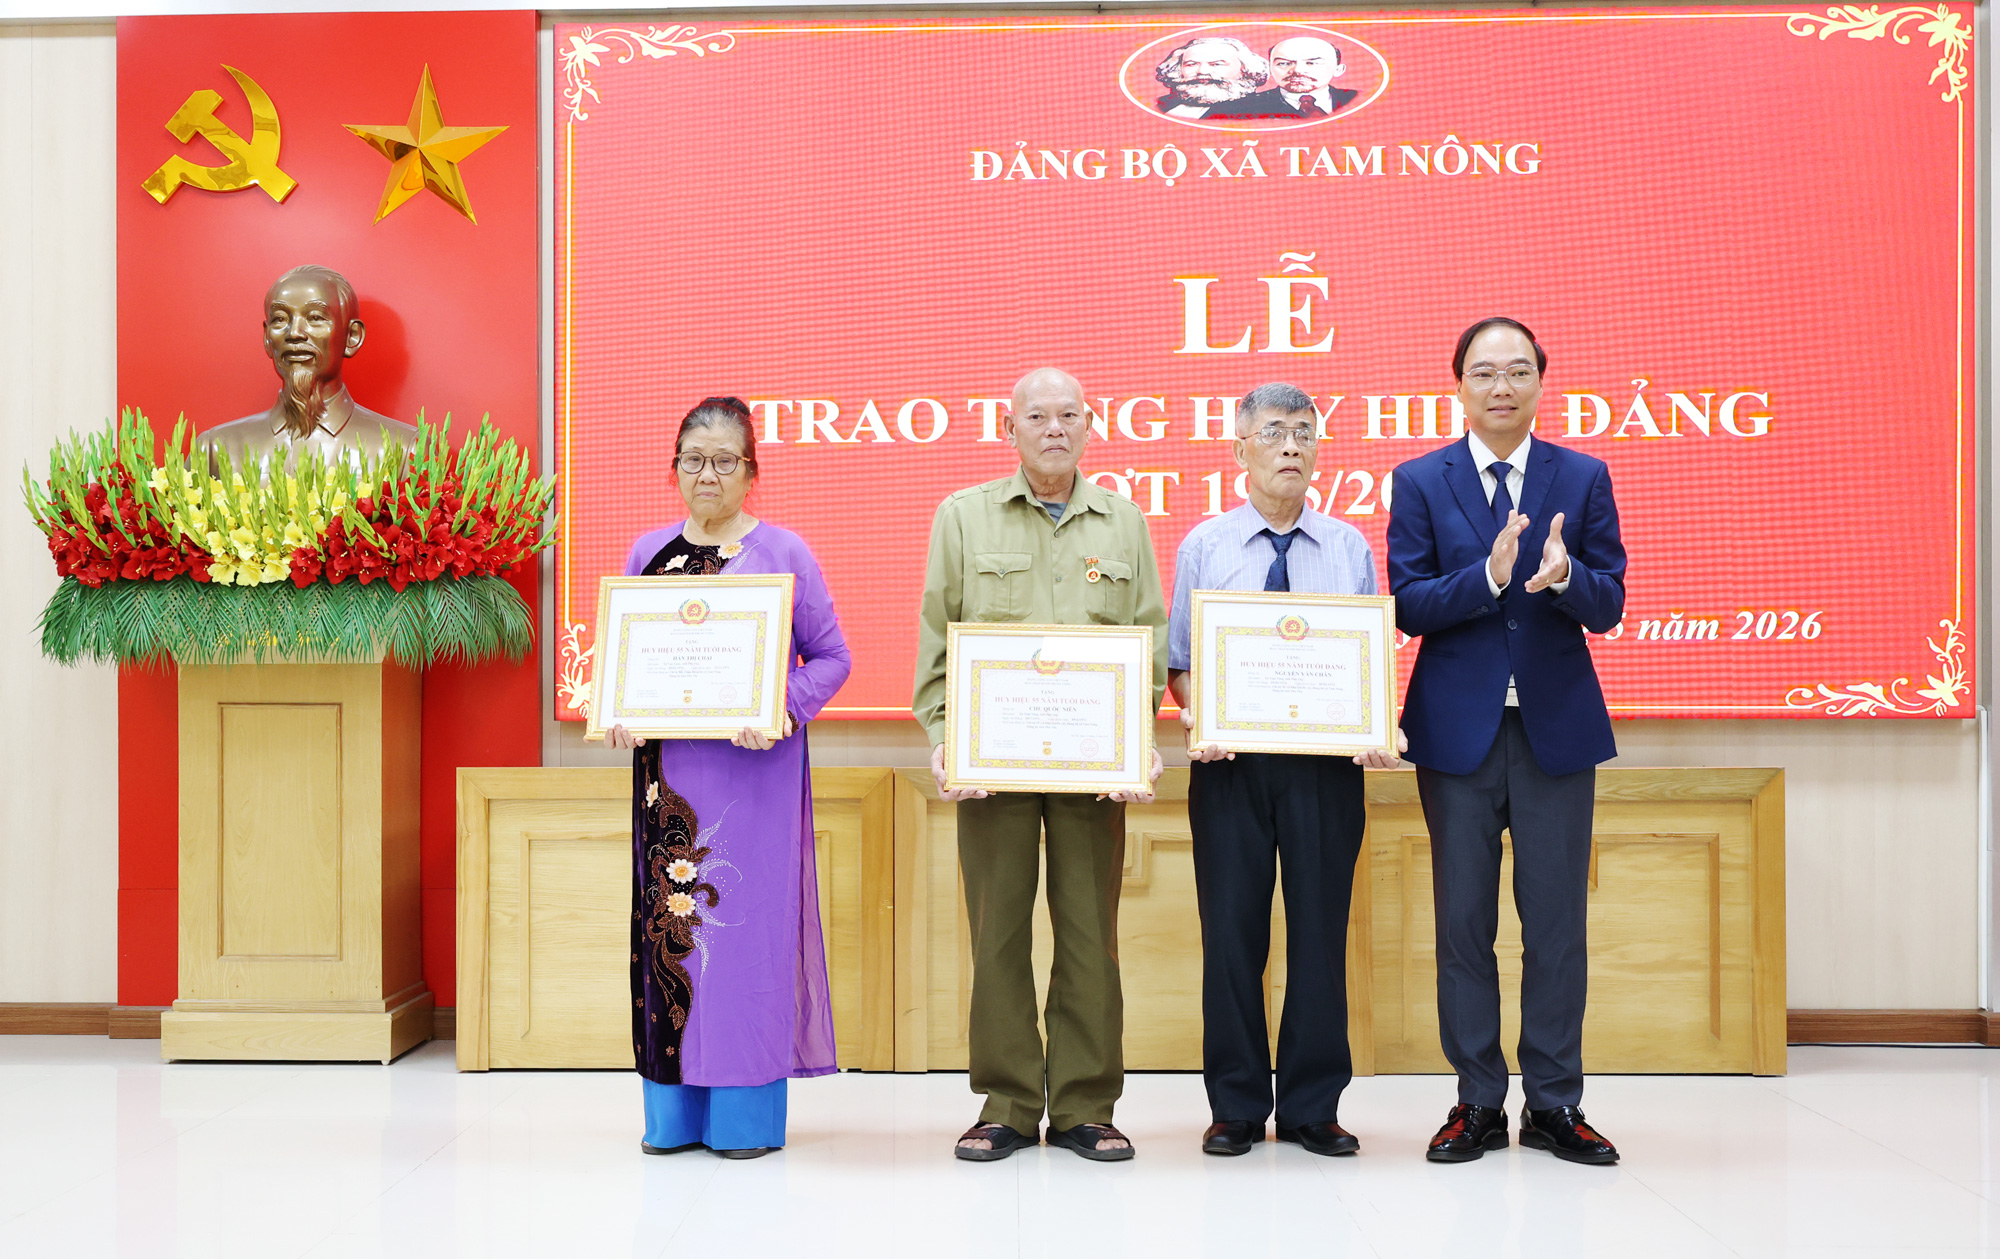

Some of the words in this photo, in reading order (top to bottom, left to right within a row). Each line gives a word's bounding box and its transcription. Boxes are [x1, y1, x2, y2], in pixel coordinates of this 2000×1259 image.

[970, 141, 1108, 181] ĐẢNG
[1120, 143, 1188, 187] BỘ
[1201, 139, 1268, 178] XÃ
[1280, 145, 1386, 177] TAM
[1398, 134, 1542, 175] NÔNG
[1173, 251, 1335, 354] LỄ
[751, 398, 950, 443] TRAO
[968, 396, 1170, 442] TNG
[1188, 396, 1345, 441] HY
[1562, 378, 1774, 438] ĐẢNG
[1637, 611, 1720, 641] năm
[1731, 610, 1824, 640] 2026
